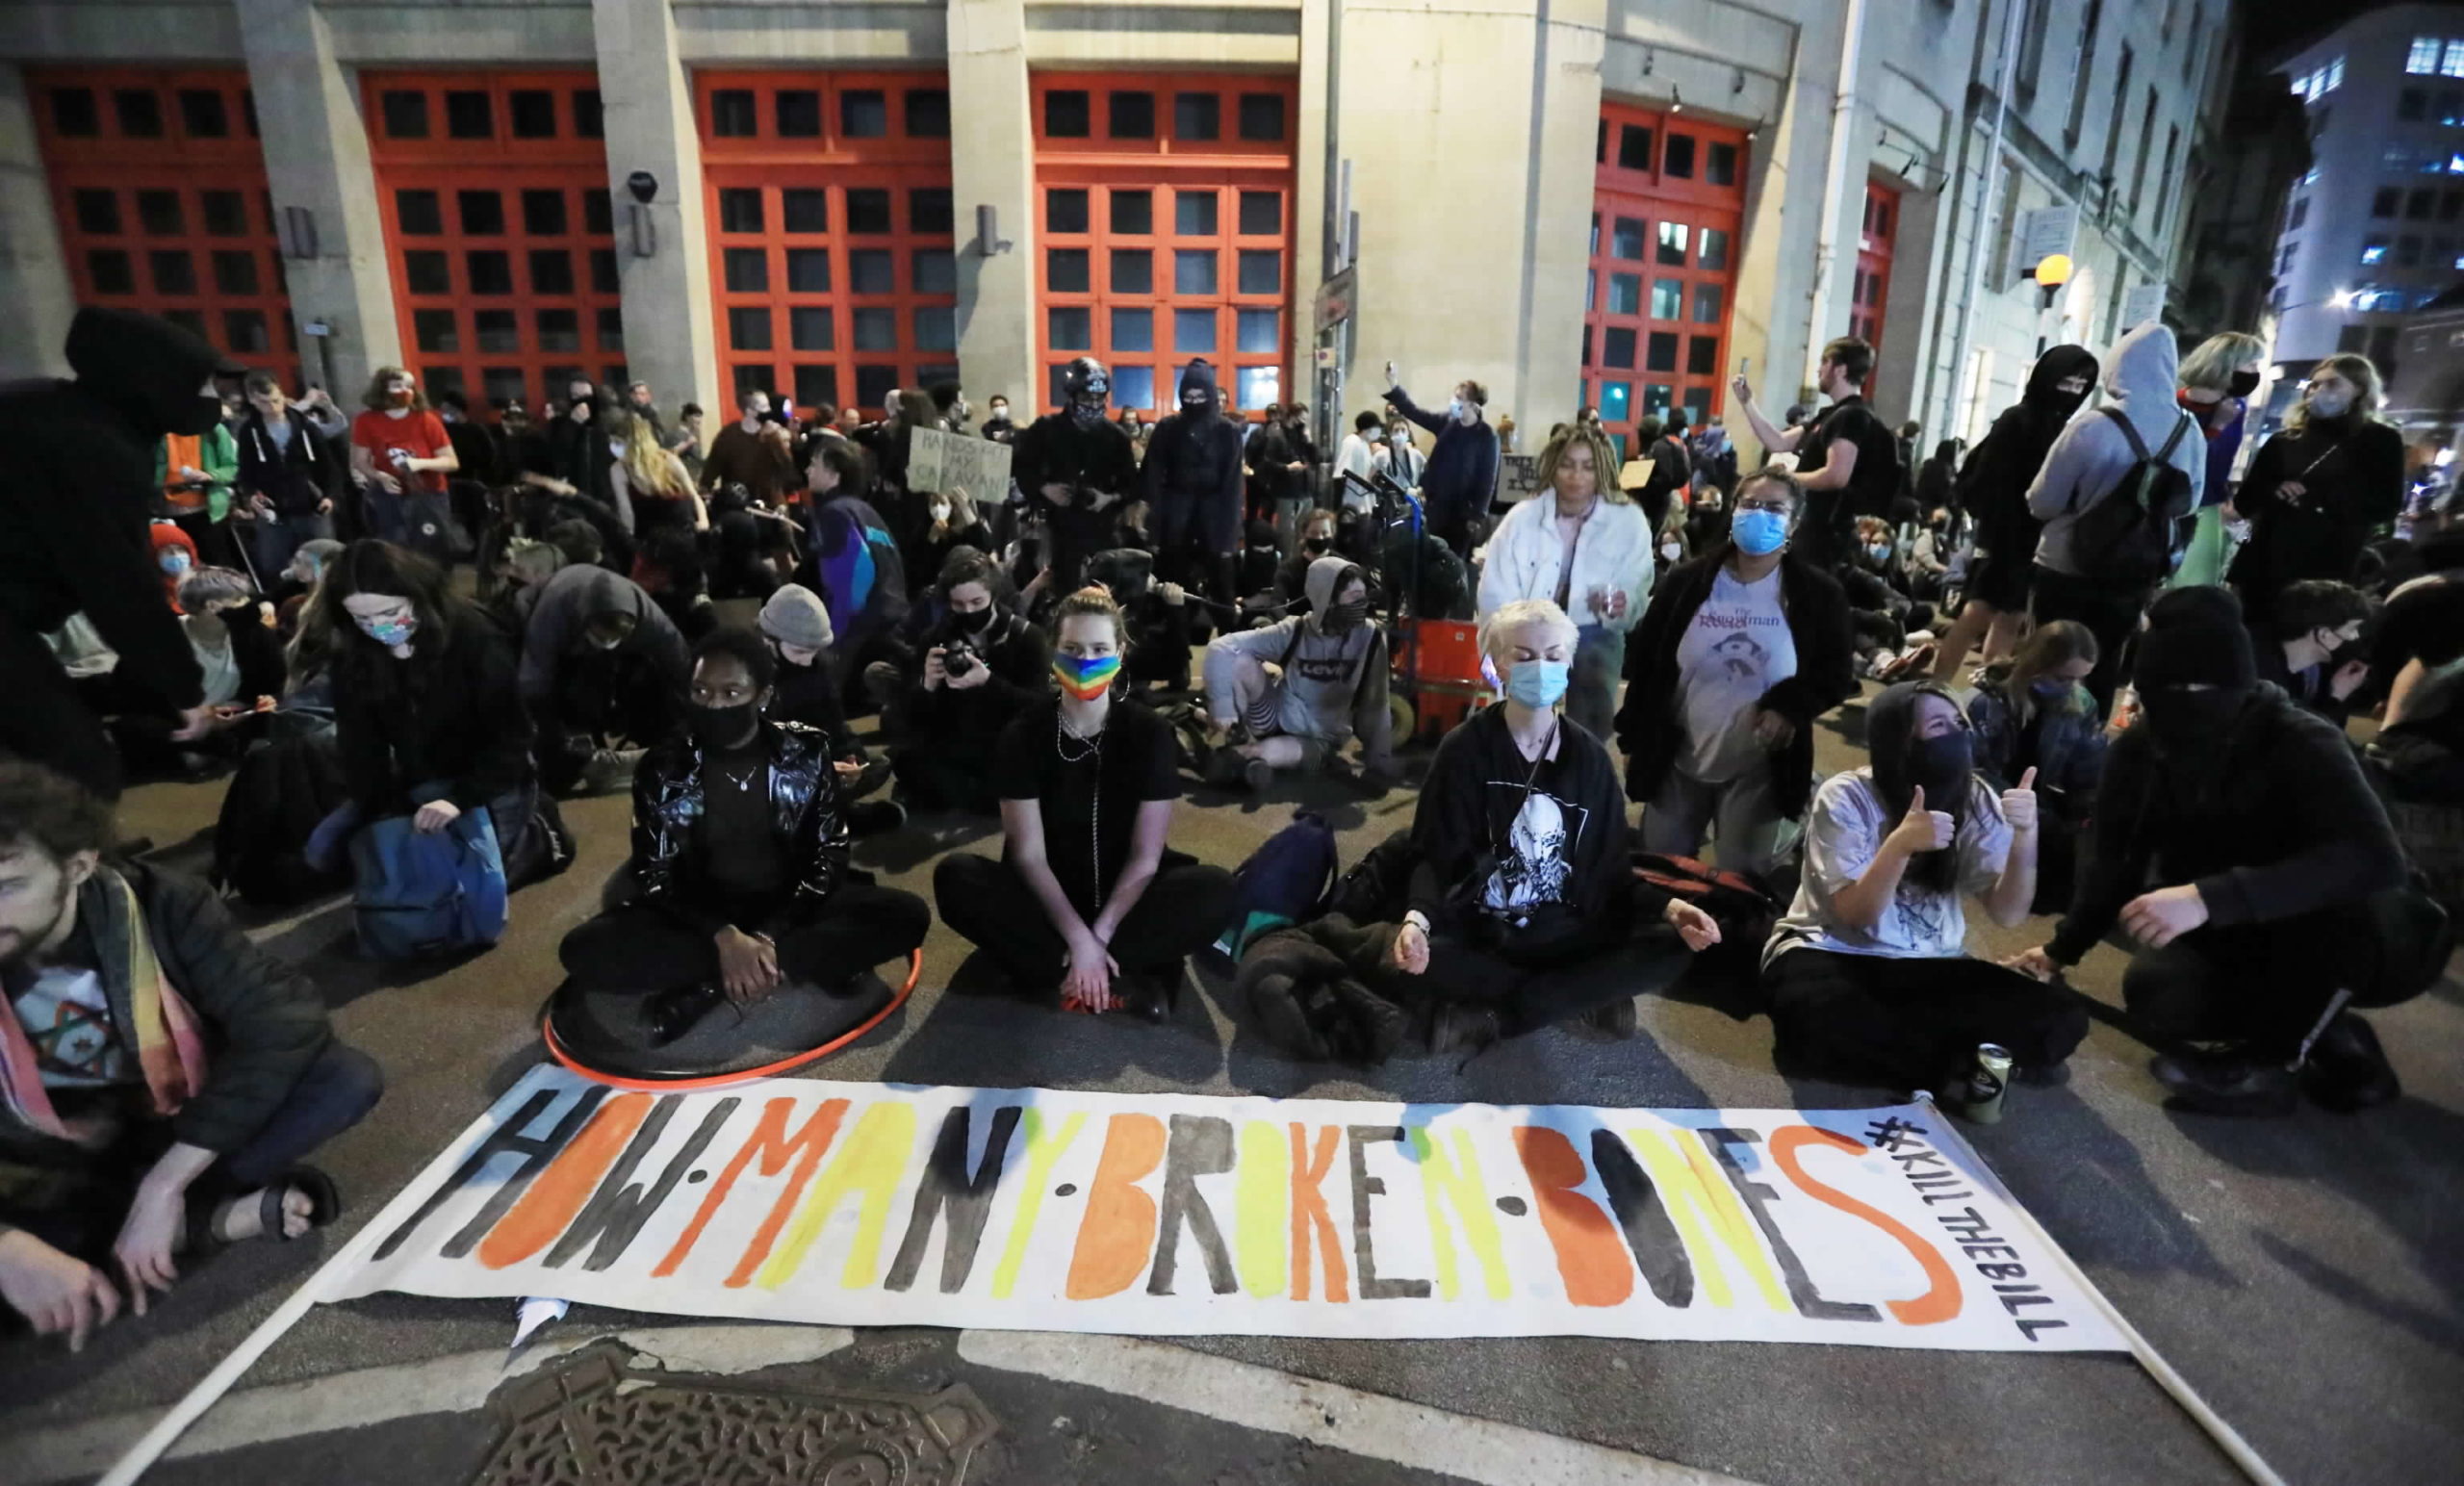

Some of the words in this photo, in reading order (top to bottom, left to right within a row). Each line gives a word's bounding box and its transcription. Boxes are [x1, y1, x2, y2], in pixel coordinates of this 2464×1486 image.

[371, 1086, 742, 1271] HOW
[650, 1096, 1090, 1299] MANY
[1065, 1112, 1513, 1303] BROKEN
[1512, 1124, 1964, 1326] BONES
